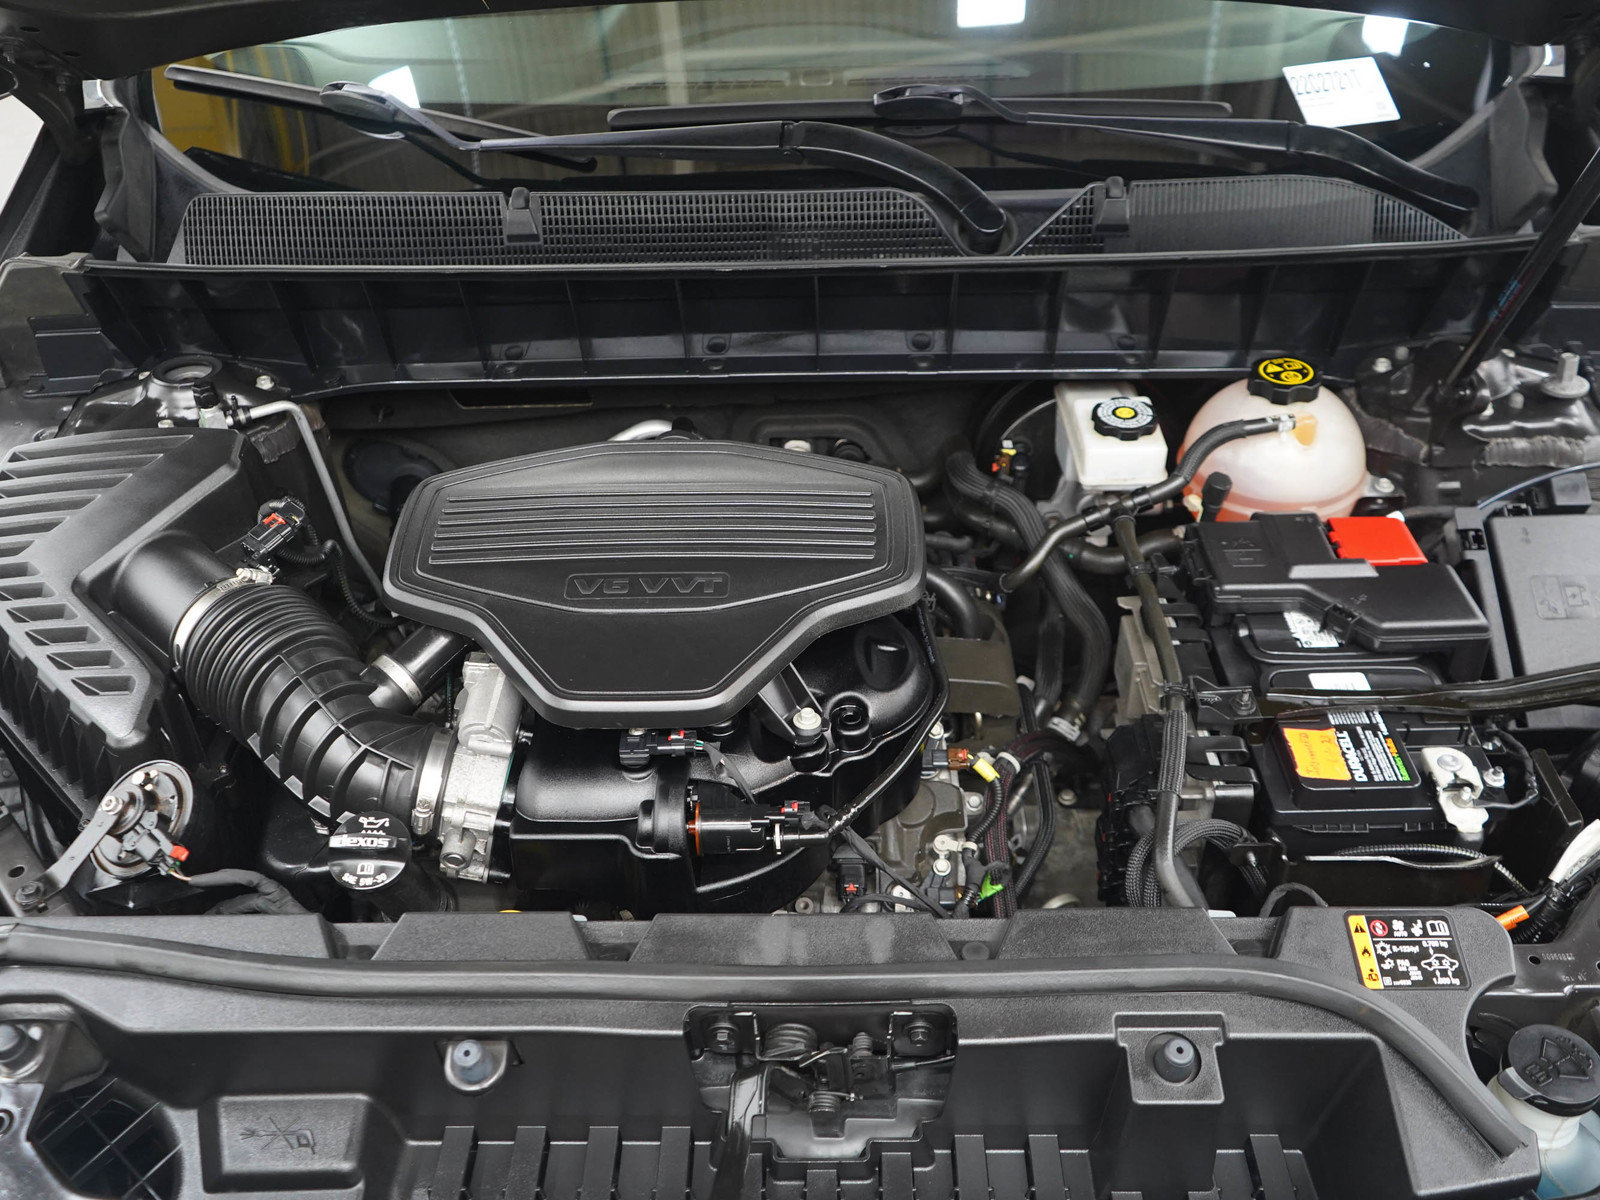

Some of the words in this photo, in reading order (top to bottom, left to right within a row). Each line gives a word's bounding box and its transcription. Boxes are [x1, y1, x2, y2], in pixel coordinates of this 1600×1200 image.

[573, 577, 631, 595] V6
[638, 576, 724, 594] VVT
[1337, 730, 1368, 782] DURACELL
[335, 834, 391, 848] dexos
